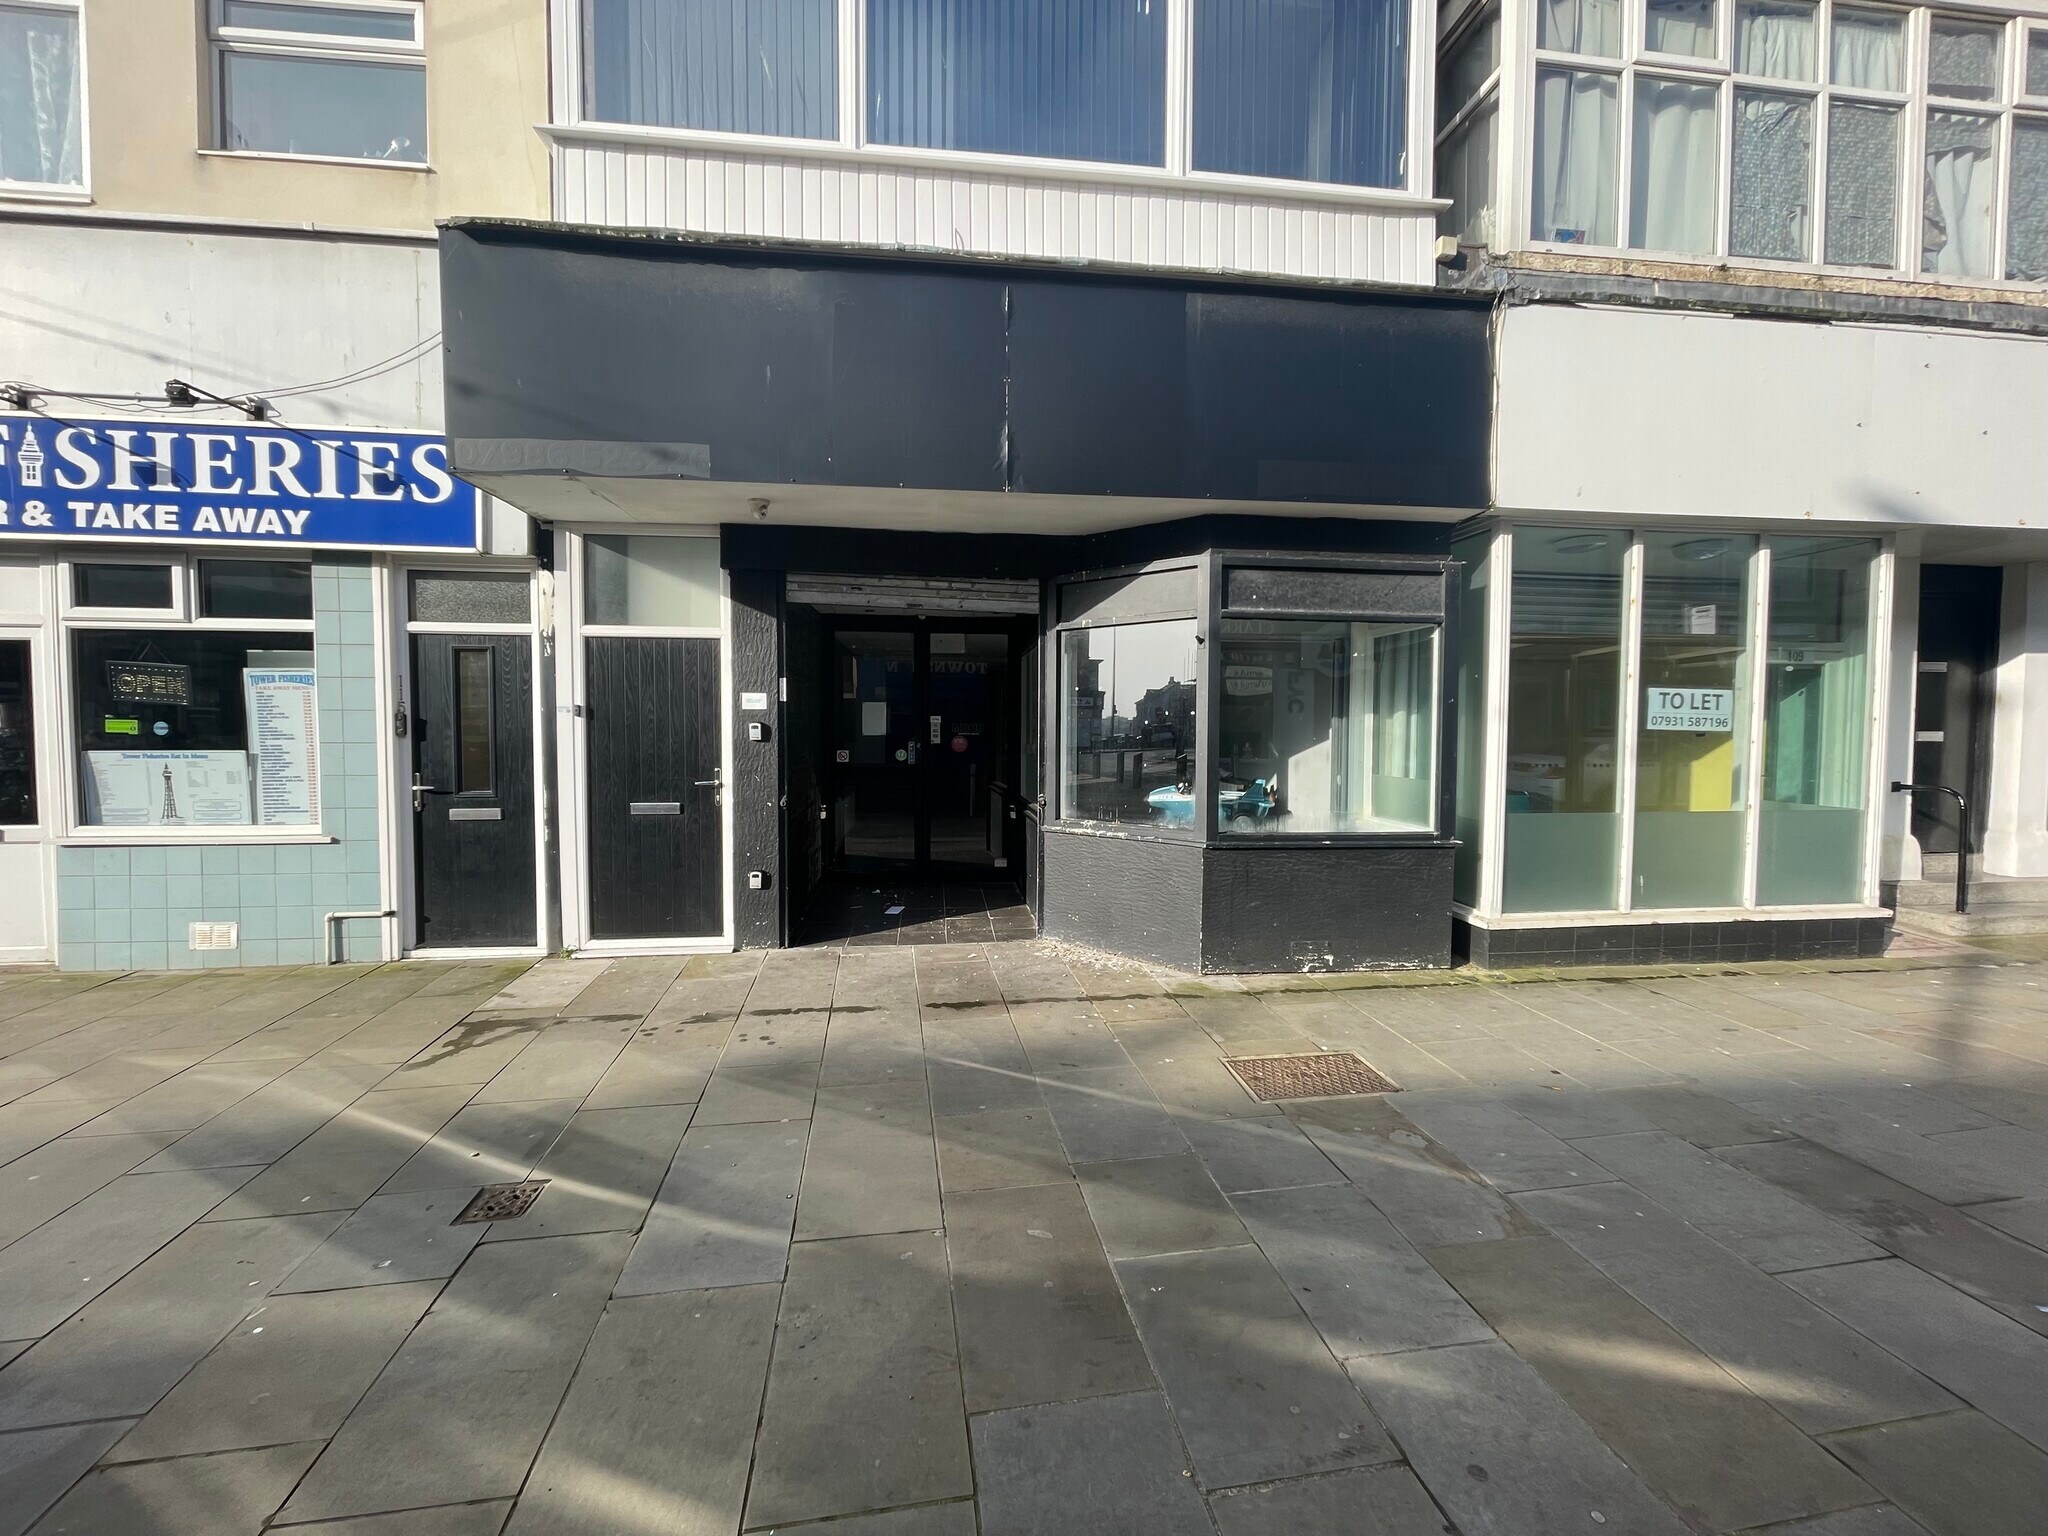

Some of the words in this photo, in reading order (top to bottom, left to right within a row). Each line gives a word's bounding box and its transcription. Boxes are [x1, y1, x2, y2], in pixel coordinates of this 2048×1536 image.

[21, 500, 53, 527] &
[67, 501, 180, 531] TAKE
[192, 506, 311, 535] AWAY
[1787, 650, 1804, 662] 109
[116, 673, 183, 696] OPEN
[250, 674, 276, 687] TOWER
[278, 674, 315, 687] FISHERIES
[1658, 692, 1685, 710] TO
[1690, 693, 1724, 711] LET
[1651, 715, 1684, 727] 07931
[1687, 717, 1728, 728] 587196
